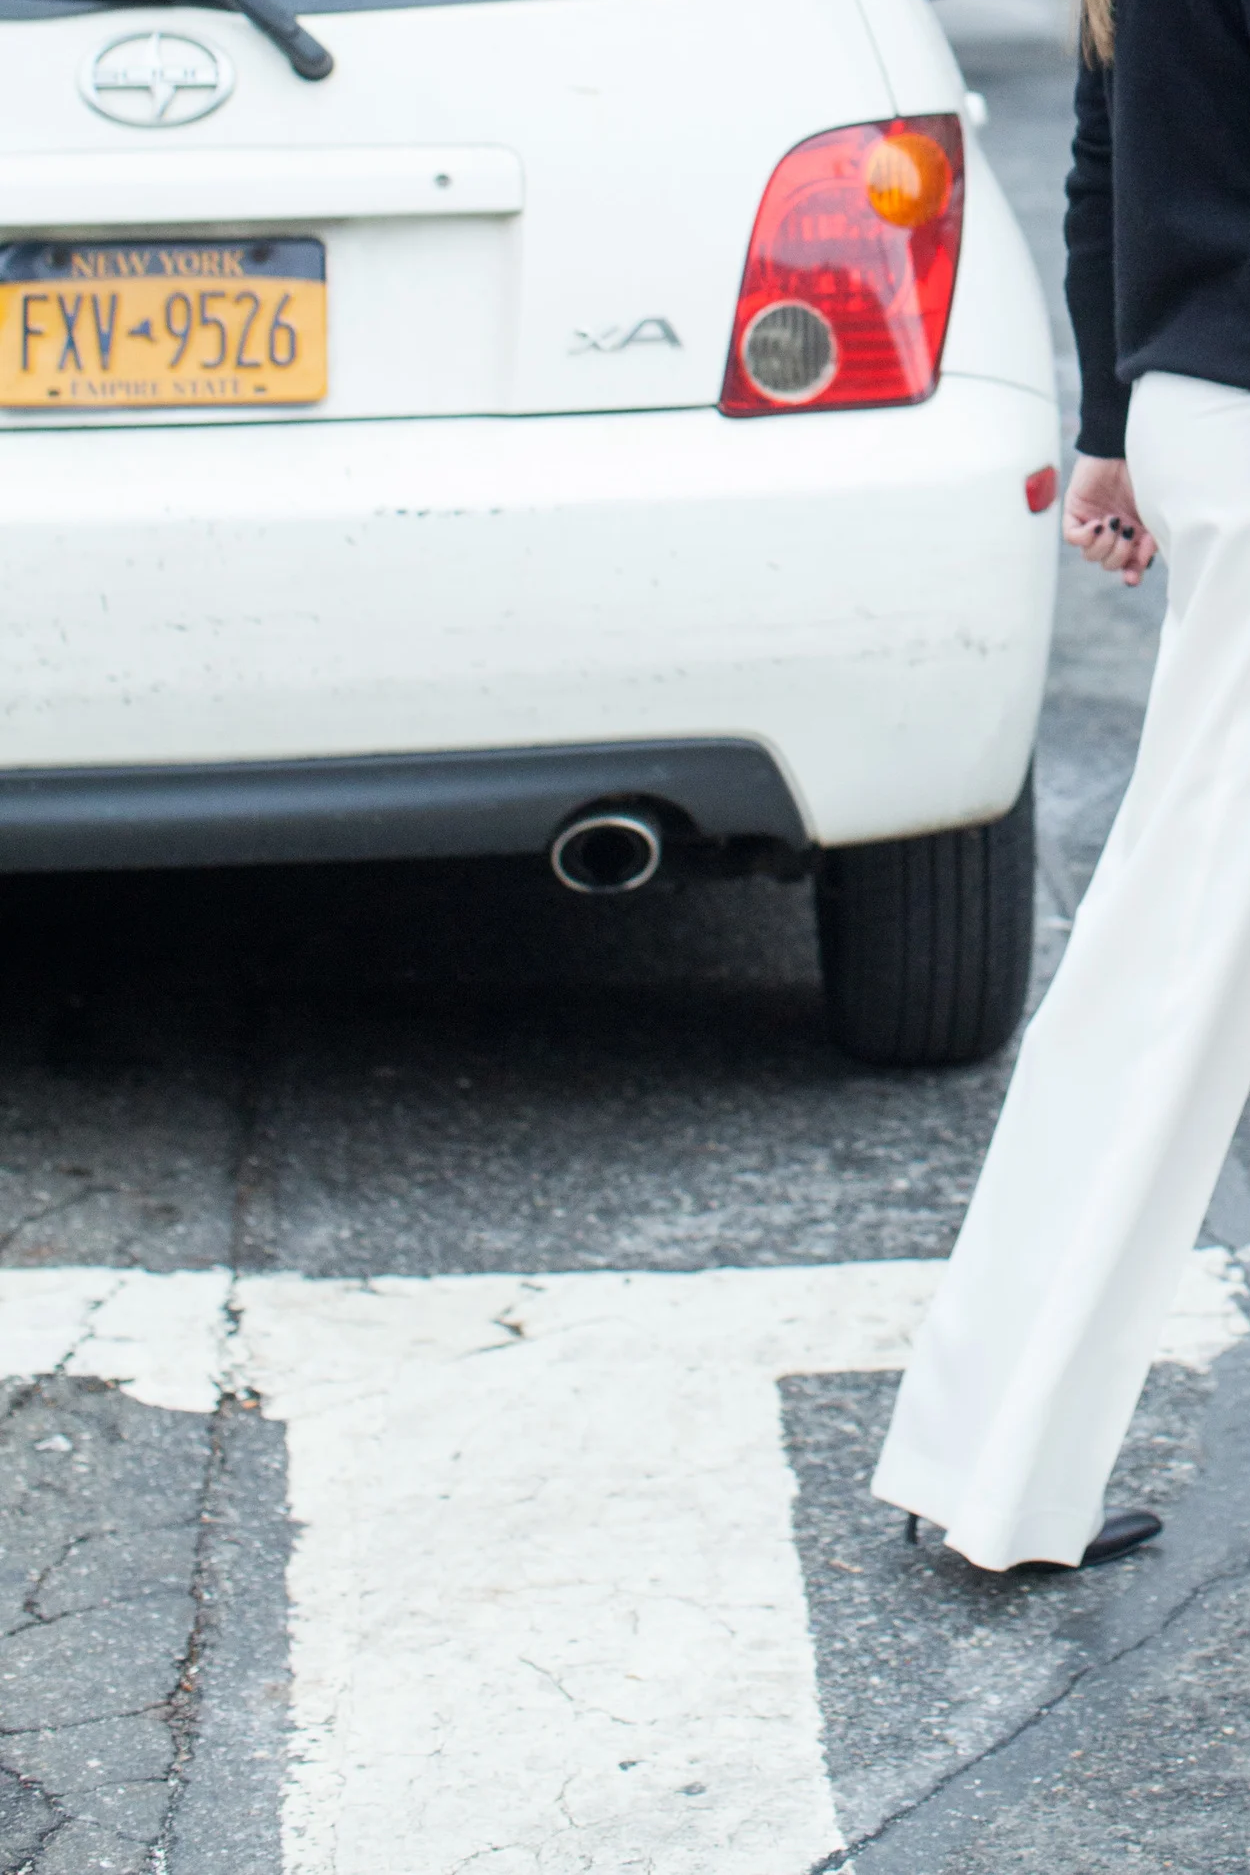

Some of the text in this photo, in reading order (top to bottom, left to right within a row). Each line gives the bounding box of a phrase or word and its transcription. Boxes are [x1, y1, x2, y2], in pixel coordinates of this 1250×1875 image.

[71, 249, 244, 278] NEW YORK
[22, 290, 297, 371] FXV 9526
[70, 377, 240, 399] EMPIRE STATE
